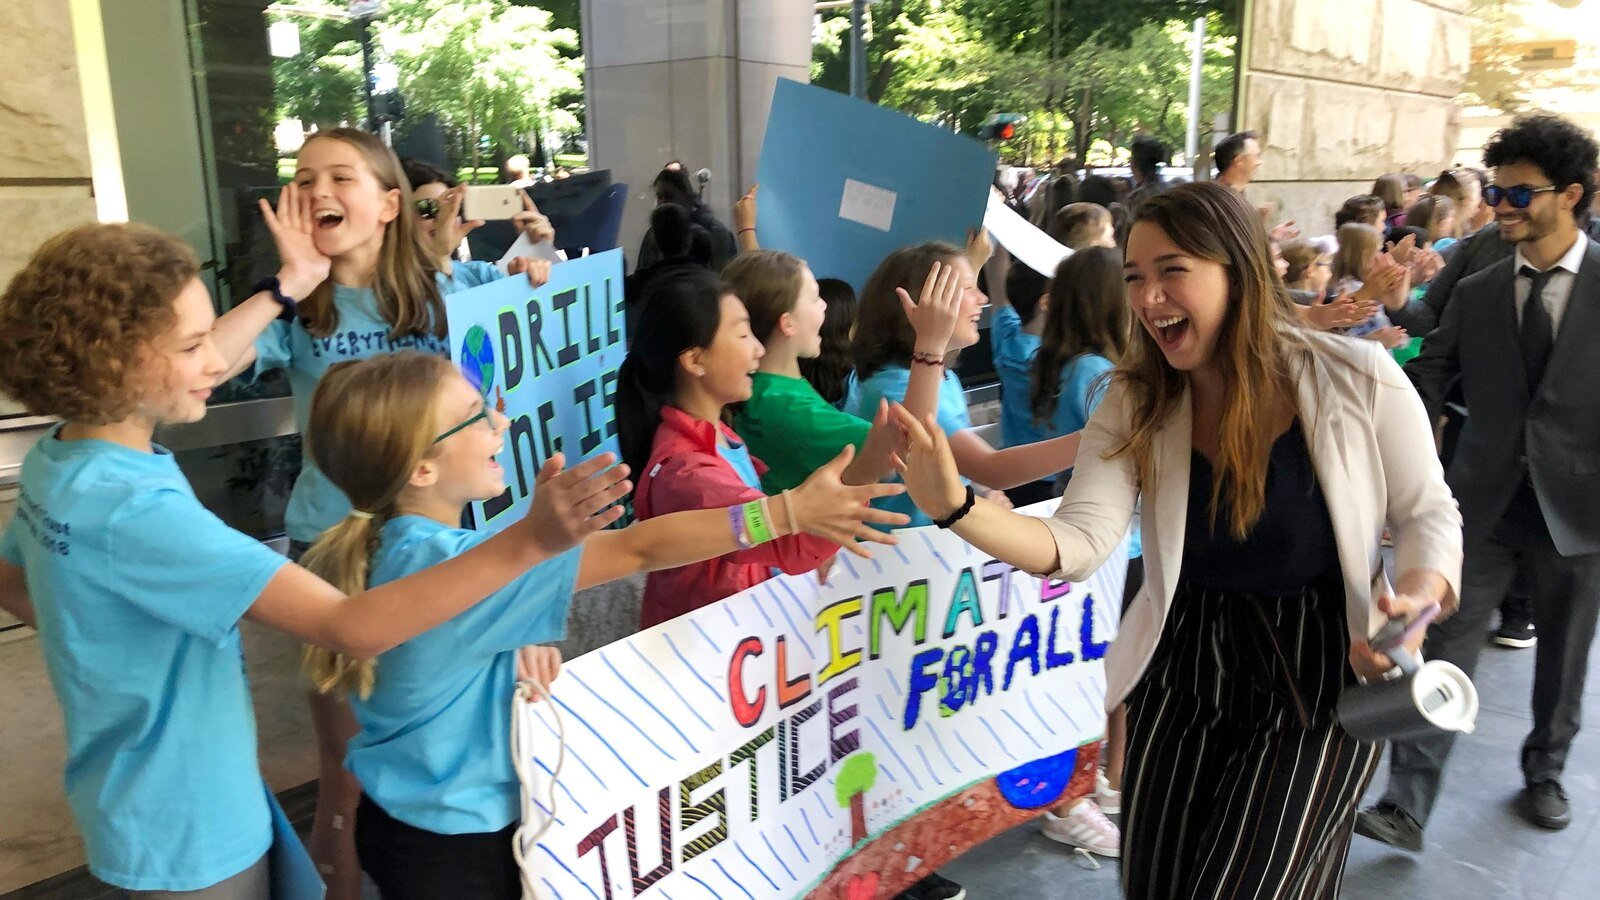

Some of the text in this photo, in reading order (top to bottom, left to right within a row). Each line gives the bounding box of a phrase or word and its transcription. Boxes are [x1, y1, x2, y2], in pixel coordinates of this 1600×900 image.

[311, 327, 448, 358] EVERYTHN
[903, 630, 999, 731] FOR
[1002, 593, 1109, 691] ALL
